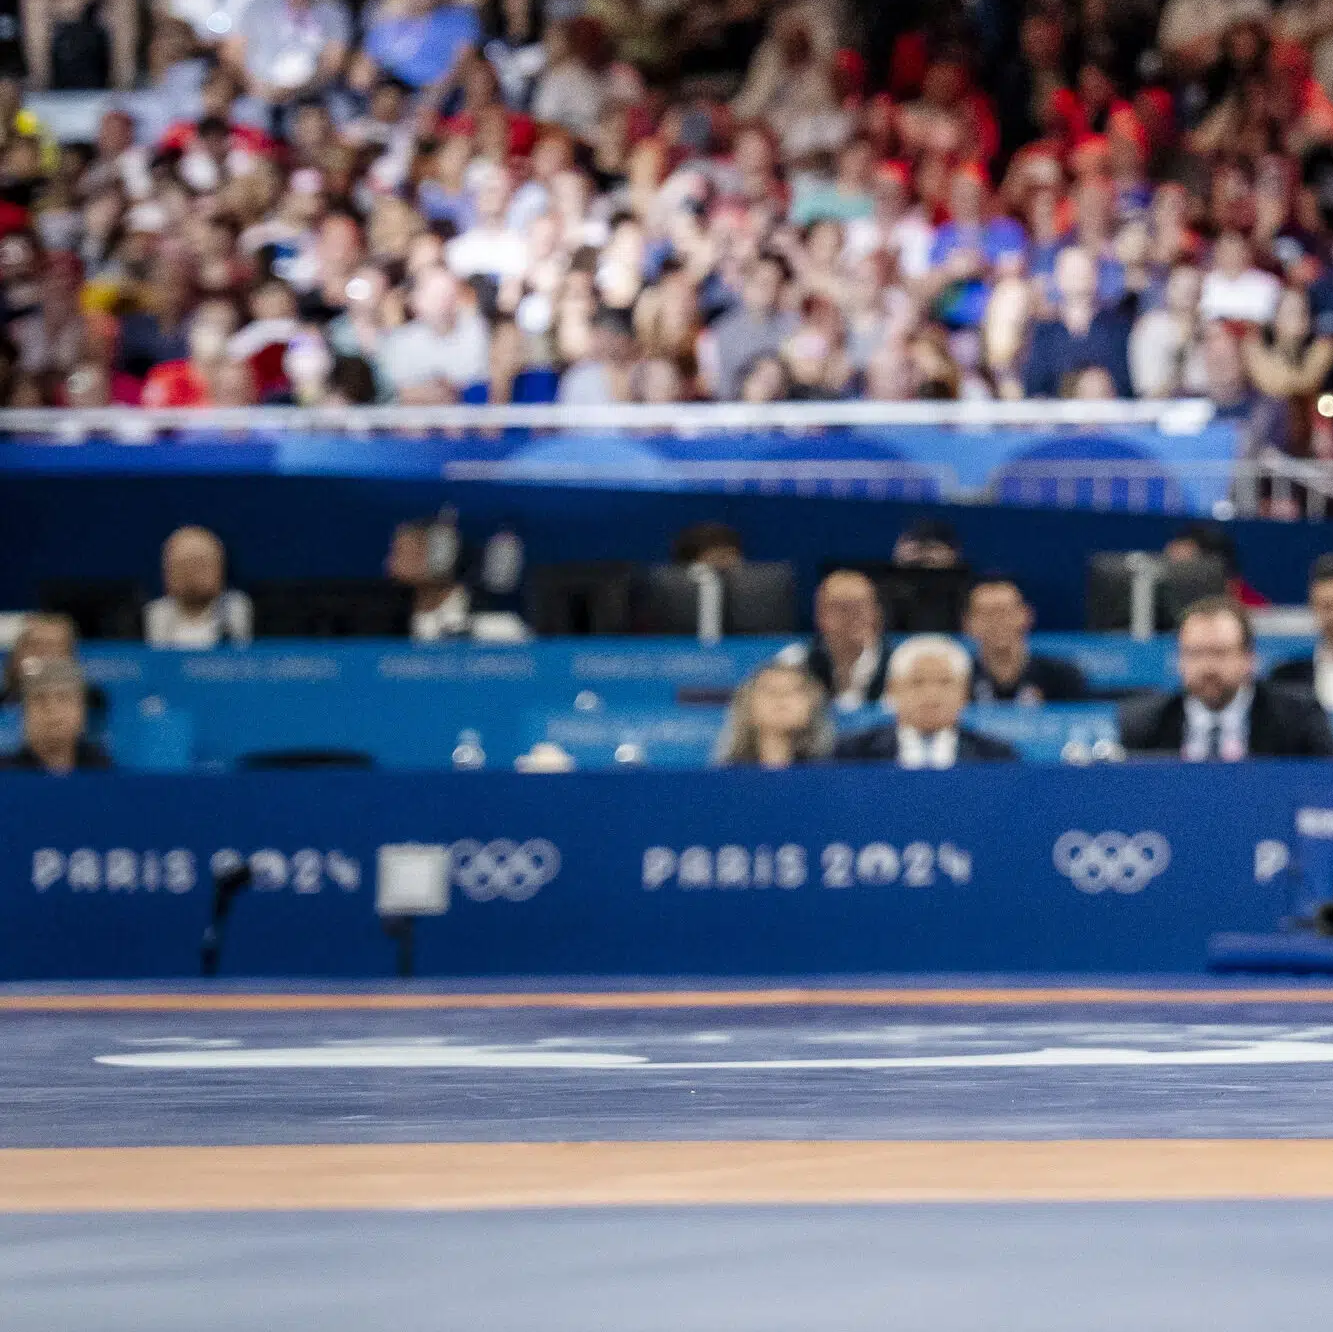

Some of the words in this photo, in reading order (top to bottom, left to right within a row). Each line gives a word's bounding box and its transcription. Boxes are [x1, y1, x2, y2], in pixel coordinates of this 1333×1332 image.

[32, 847, 197, 894] PARIS
[642, 843, 808, 891] PARIS
[820, 842, 973, 888] 2024
